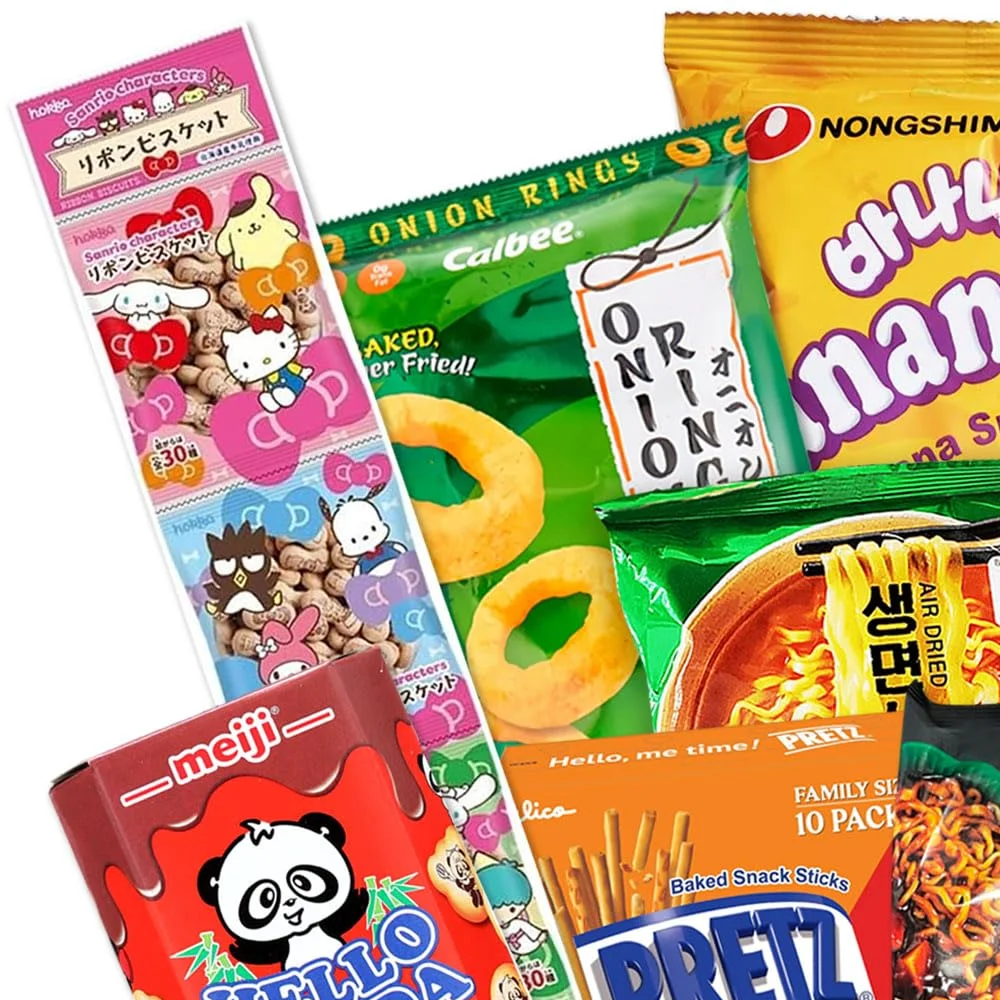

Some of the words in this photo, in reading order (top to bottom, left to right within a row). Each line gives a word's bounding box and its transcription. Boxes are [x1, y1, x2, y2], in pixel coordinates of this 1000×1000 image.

[65, 90, 114, 126] Sanrio
[115, 68, 207, 98] characters
[78, 110, 229, 175] リボンビスケット
[368, 194, 496, 247] ONION
[519, 150, 643, 209] RINGS
[85, 241, 128, 264] Sanrio
[129, 216, 202, 249] characters
[442, 219, 575, 272] Calbee
[363, 327, 440, 359] AKED,
[366, 361, 396, 378] er
[402, 352, 476, 377] Fried!
[602, 302, 684, 490] ONIO
[919, 582, 939, 617] AIR
[862, 583, 923, 712] 생면
[924, 625, 948, 687] DRIED
[168, 704, 281, 785] meiji
[548, 753, 630, 768] Hello,
[636, 747, 679, 760] me
[685, 739, 761, 757] time!
[777, 726, 866, 751] PRETZ
[520, 800, 577, 823] lico
[794, 780, 868, 804] FAMILY
[795, 811, 825, 836] 10
[670, 872, 729, 898] Baked
[733, 868, 790, 888] Snack
[795, 867, 850, 895] Sticks
